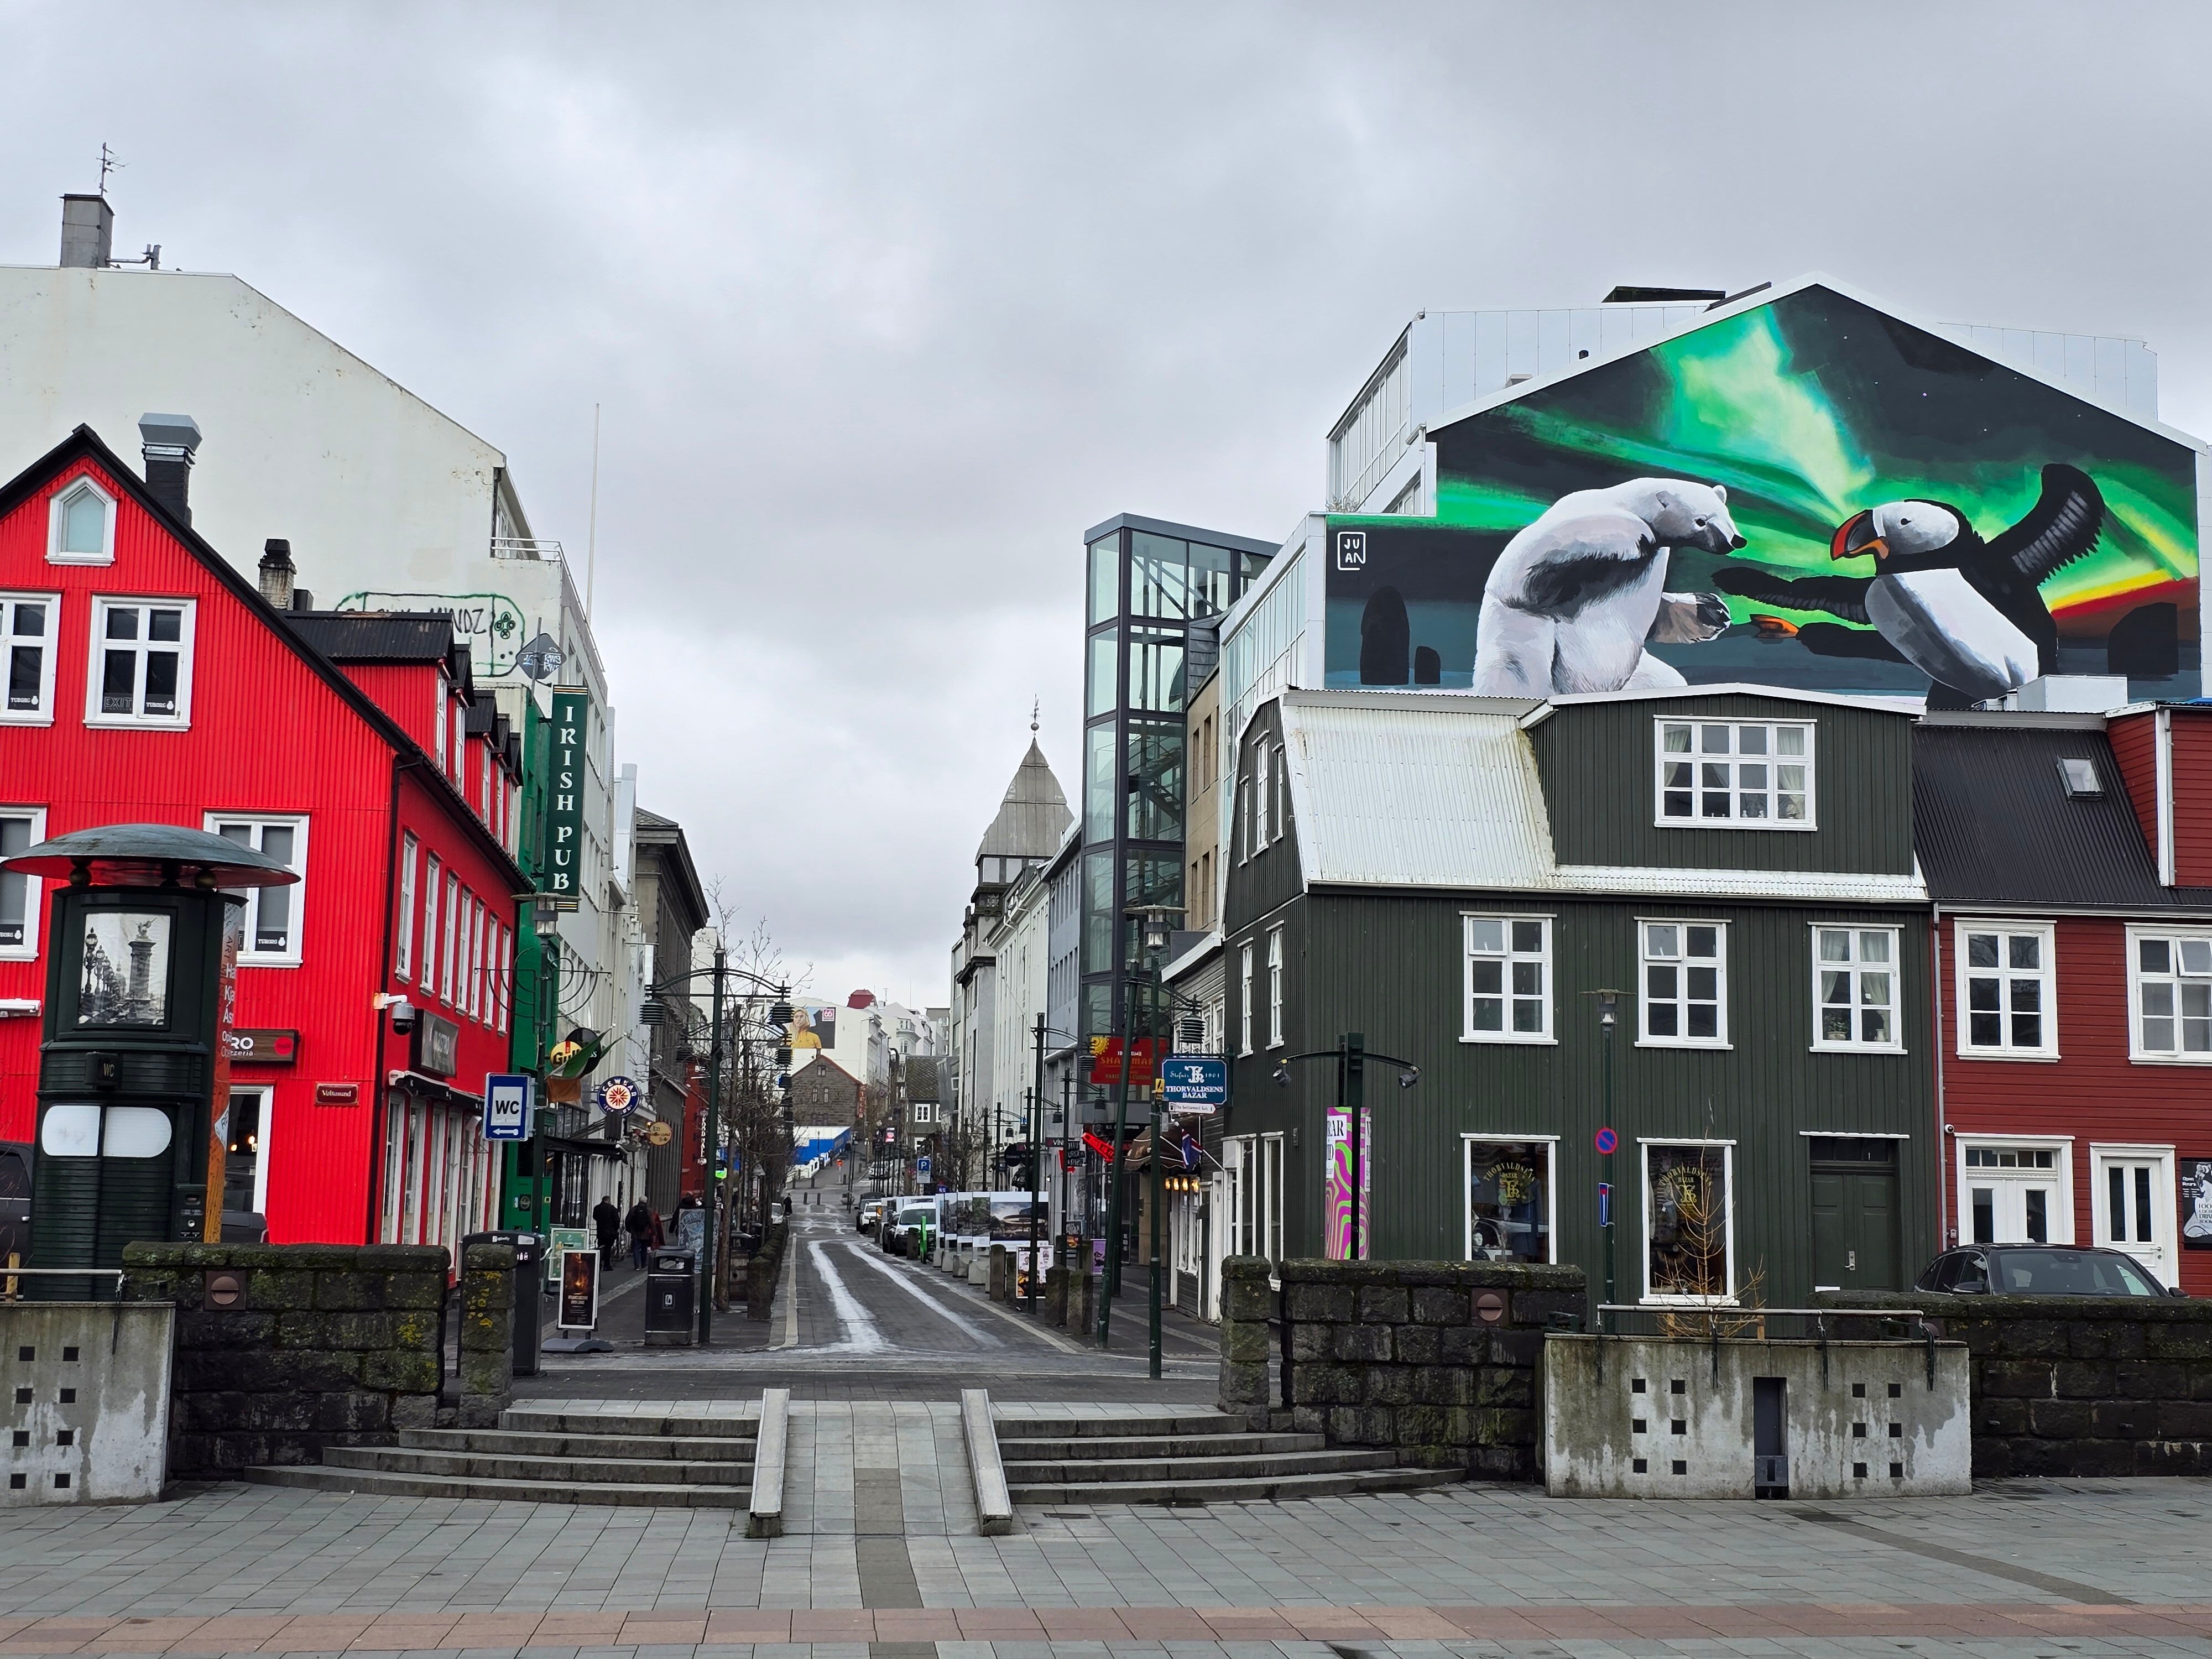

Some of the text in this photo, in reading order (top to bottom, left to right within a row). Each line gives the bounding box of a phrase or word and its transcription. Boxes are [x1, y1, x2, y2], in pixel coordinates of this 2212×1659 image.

[105, 696, 132, 708] EXIT
[553, 706, 577, 890] IRISH PUB
[103, 1063, 114, 1077] WC
[495, 1100, 519, 1115] WC
[1483, 1162, 1536, 1182] THORVALDSENS
